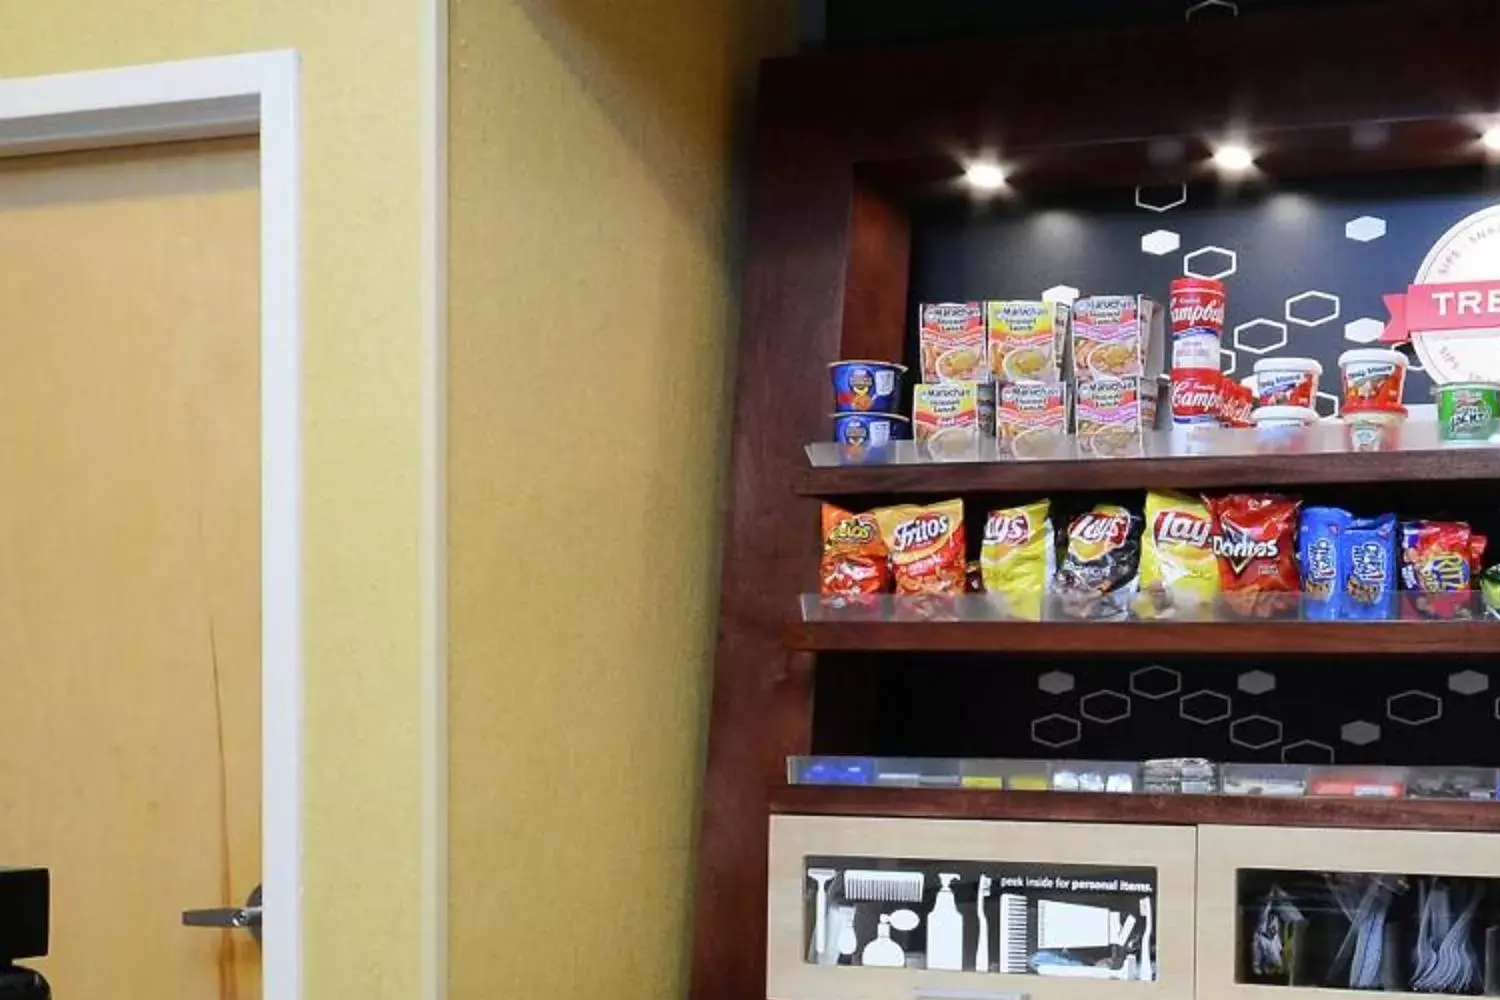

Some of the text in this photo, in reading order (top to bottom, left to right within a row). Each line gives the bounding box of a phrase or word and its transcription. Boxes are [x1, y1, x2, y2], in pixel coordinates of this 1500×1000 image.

[893, 515, 950, 551] Fritos
[1212, 535, 1279, 564] Doritos
[1001, 875, 1024, 888] peek
[1026, 876, 1054, 889] inside
[1055, 877, 1071, 889] for
[1071, 879, 1119, 891] personal
